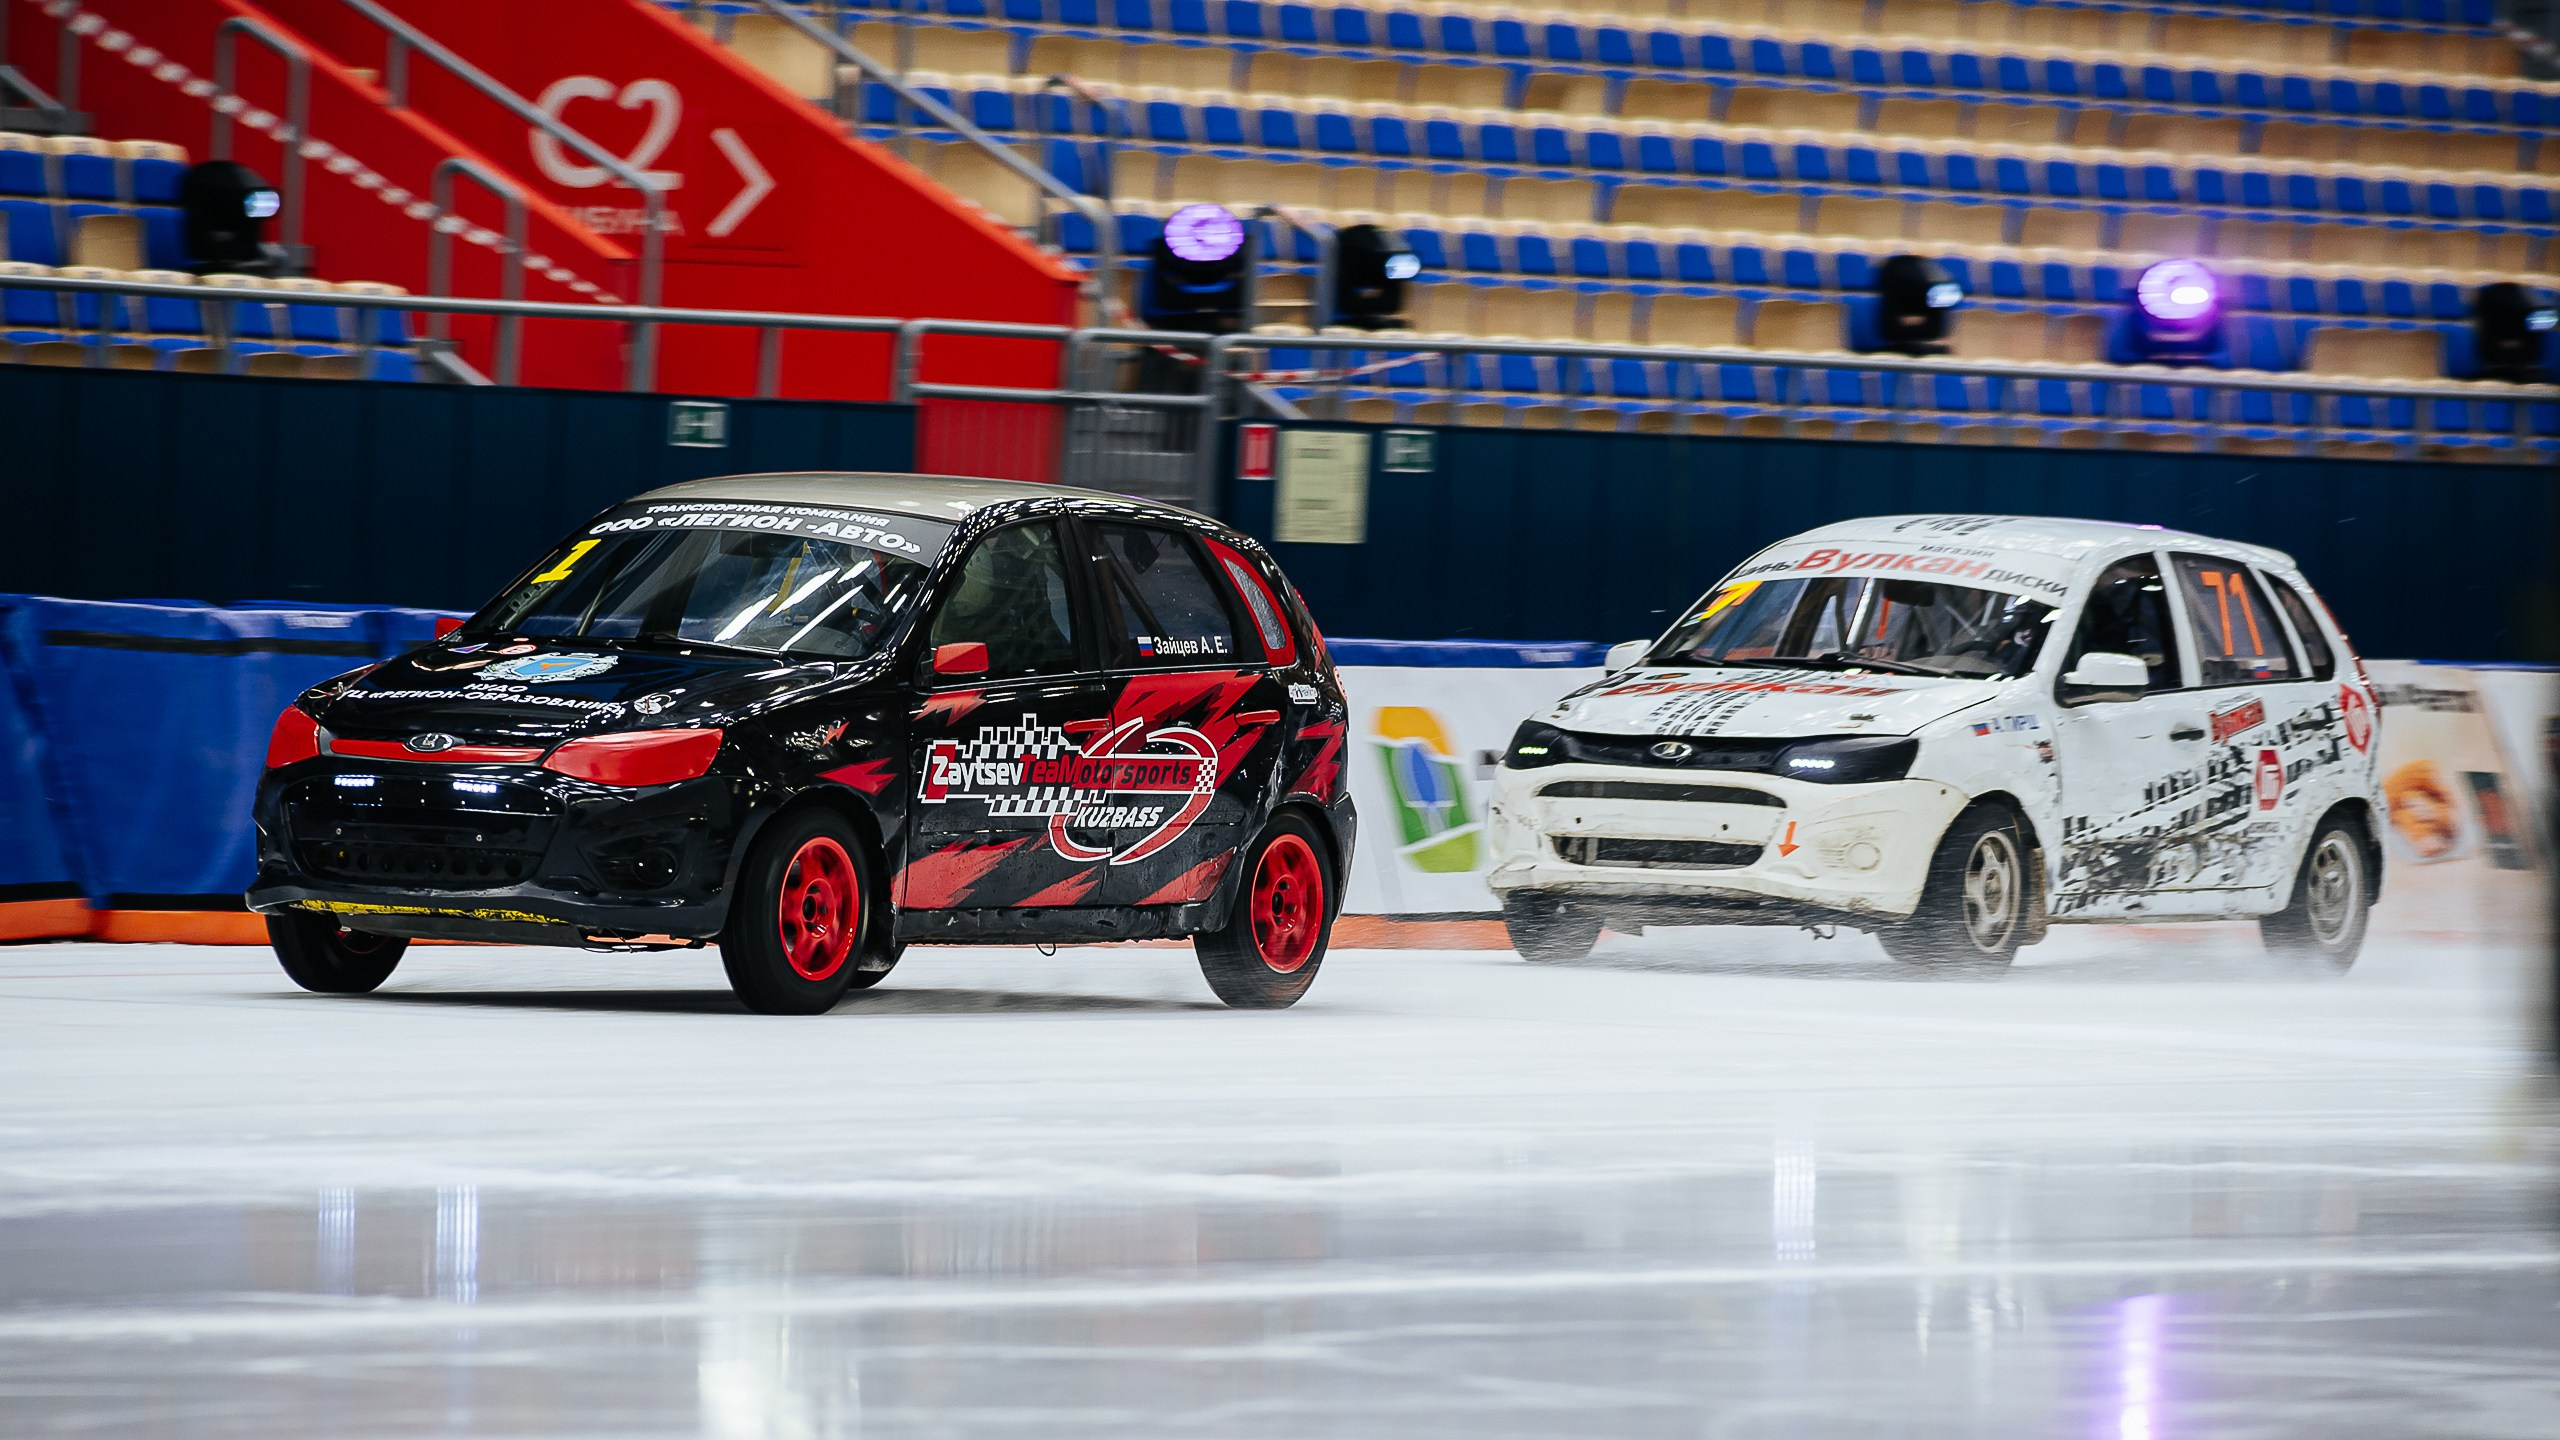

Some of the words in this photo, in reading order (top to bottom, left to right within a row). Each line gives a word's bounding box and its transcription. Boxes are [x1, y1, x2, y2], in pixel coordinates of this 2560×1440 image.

[646, 503, 785, 515] ТРАНСПОРТНАЯ
[786, 506, 890, 527] КОМПАНИЯ
[588, 517, 654, 535] ООО
[658, 513, 804, 531] «ЛЕГИОН
[805, 522, 921, 554] -АВТО»
[530, 538, 602, 585] 1
[1919, 544, 1996, 559] магазин
[1795, 548, 1990, 580] Вулкан
[1981, 568, 2069, 597] диски
[2200, 571, 2264, 656] 71
[1153, 636, 1199, 657] Зайцев
[1201, 635, 1214, 654] А.
[1214, 635, 1228, 654] Е.
[462, 683, 529, 693] НУДО
[1073, 806, 1165, 828] KUZBASS
